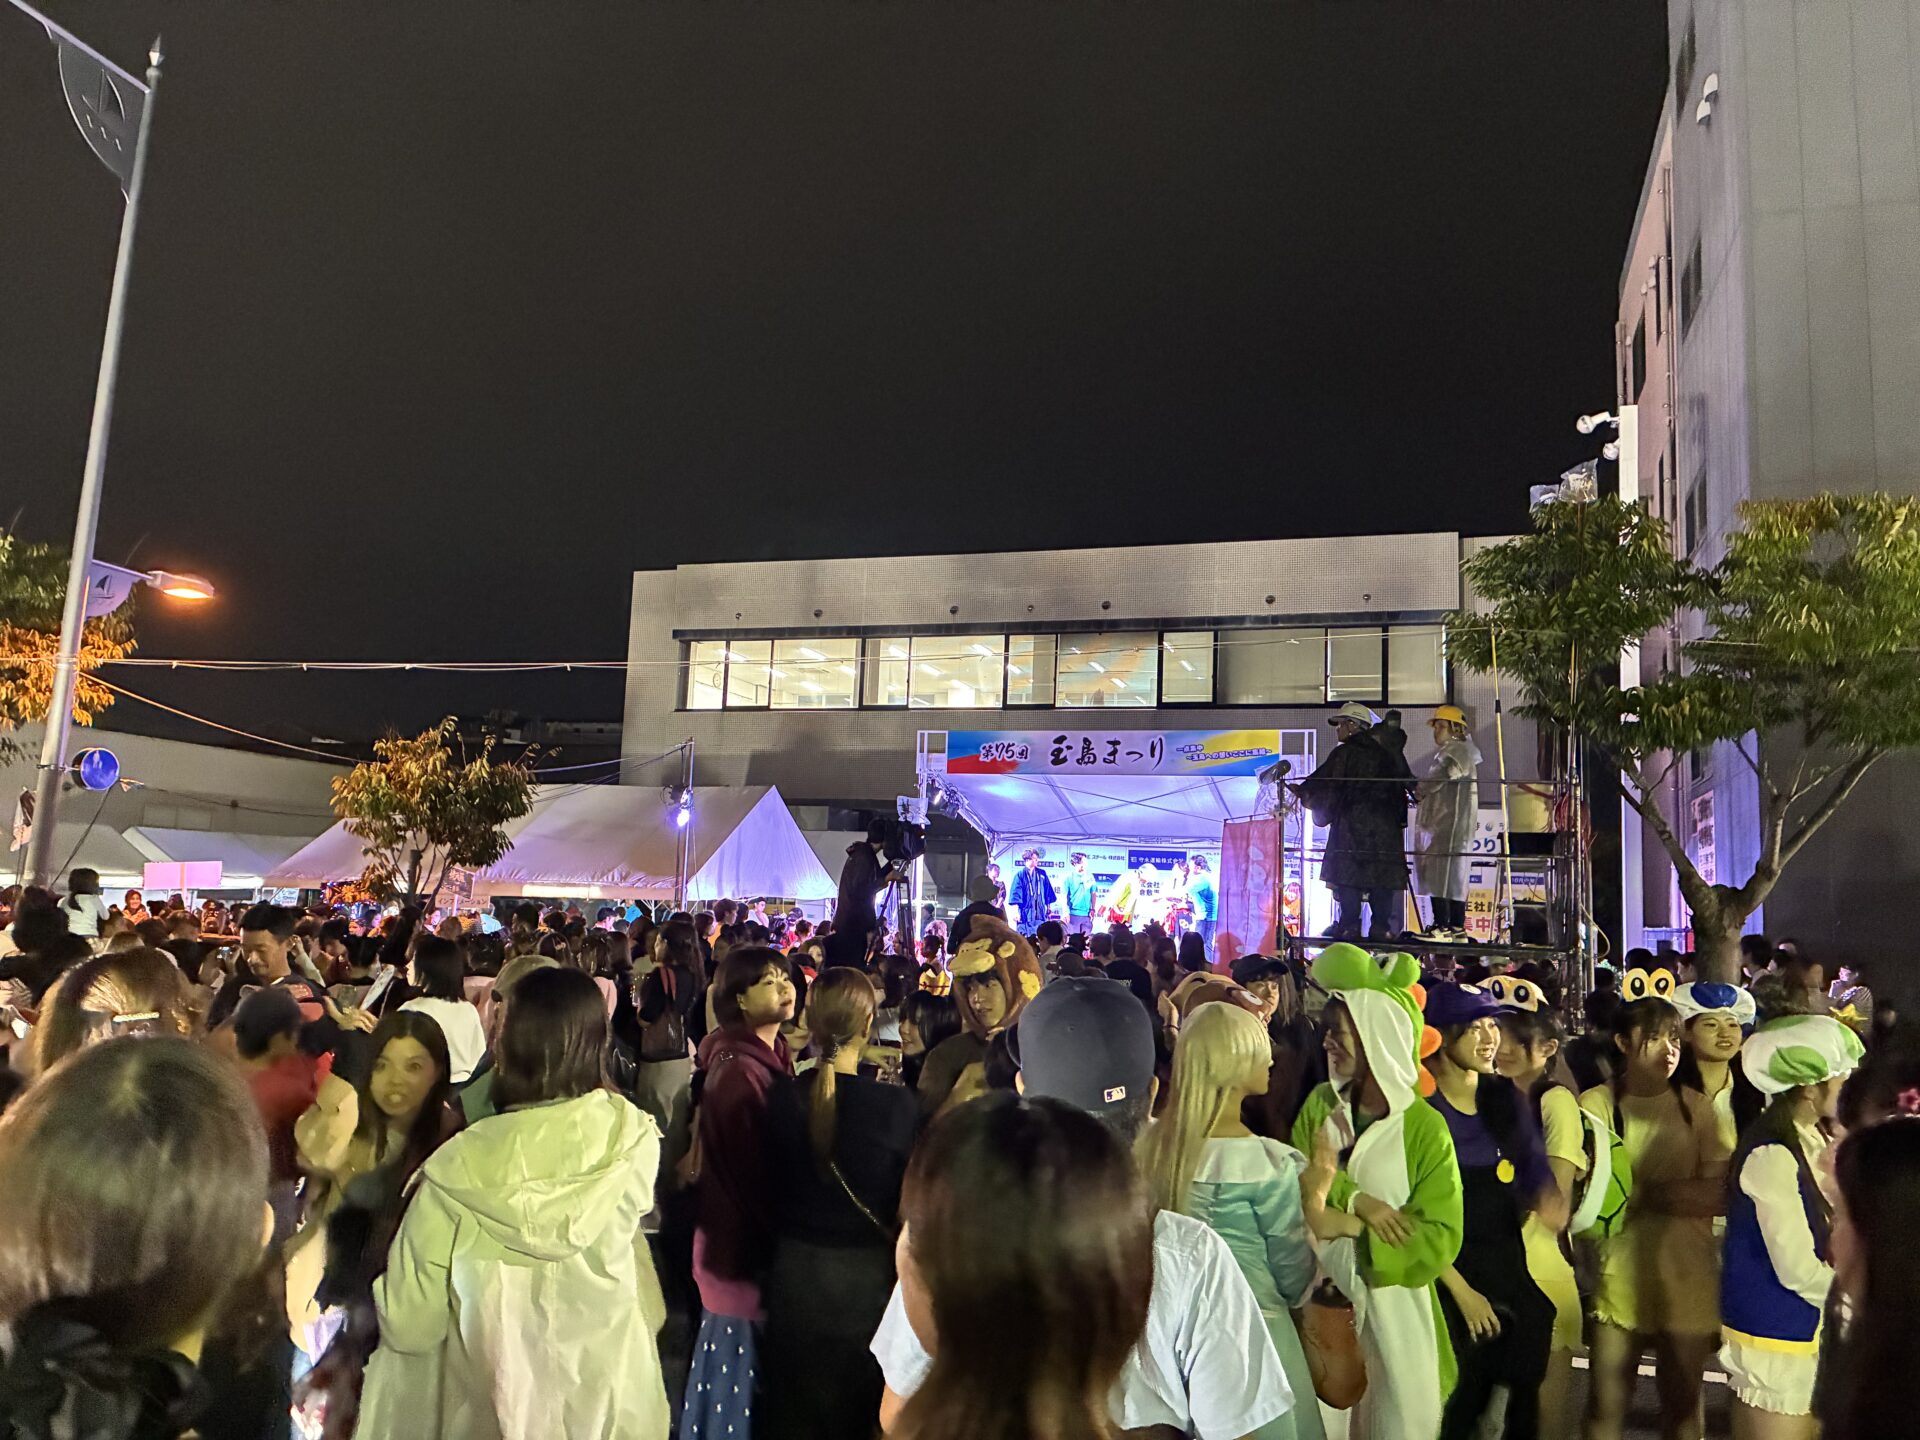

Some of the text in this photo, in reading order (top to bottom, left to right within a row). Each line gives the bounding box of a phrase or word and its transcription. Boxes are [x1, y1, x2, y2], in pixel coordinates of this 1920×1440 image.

[981, 734, 1165, 771] 第75回 玉島まつり
